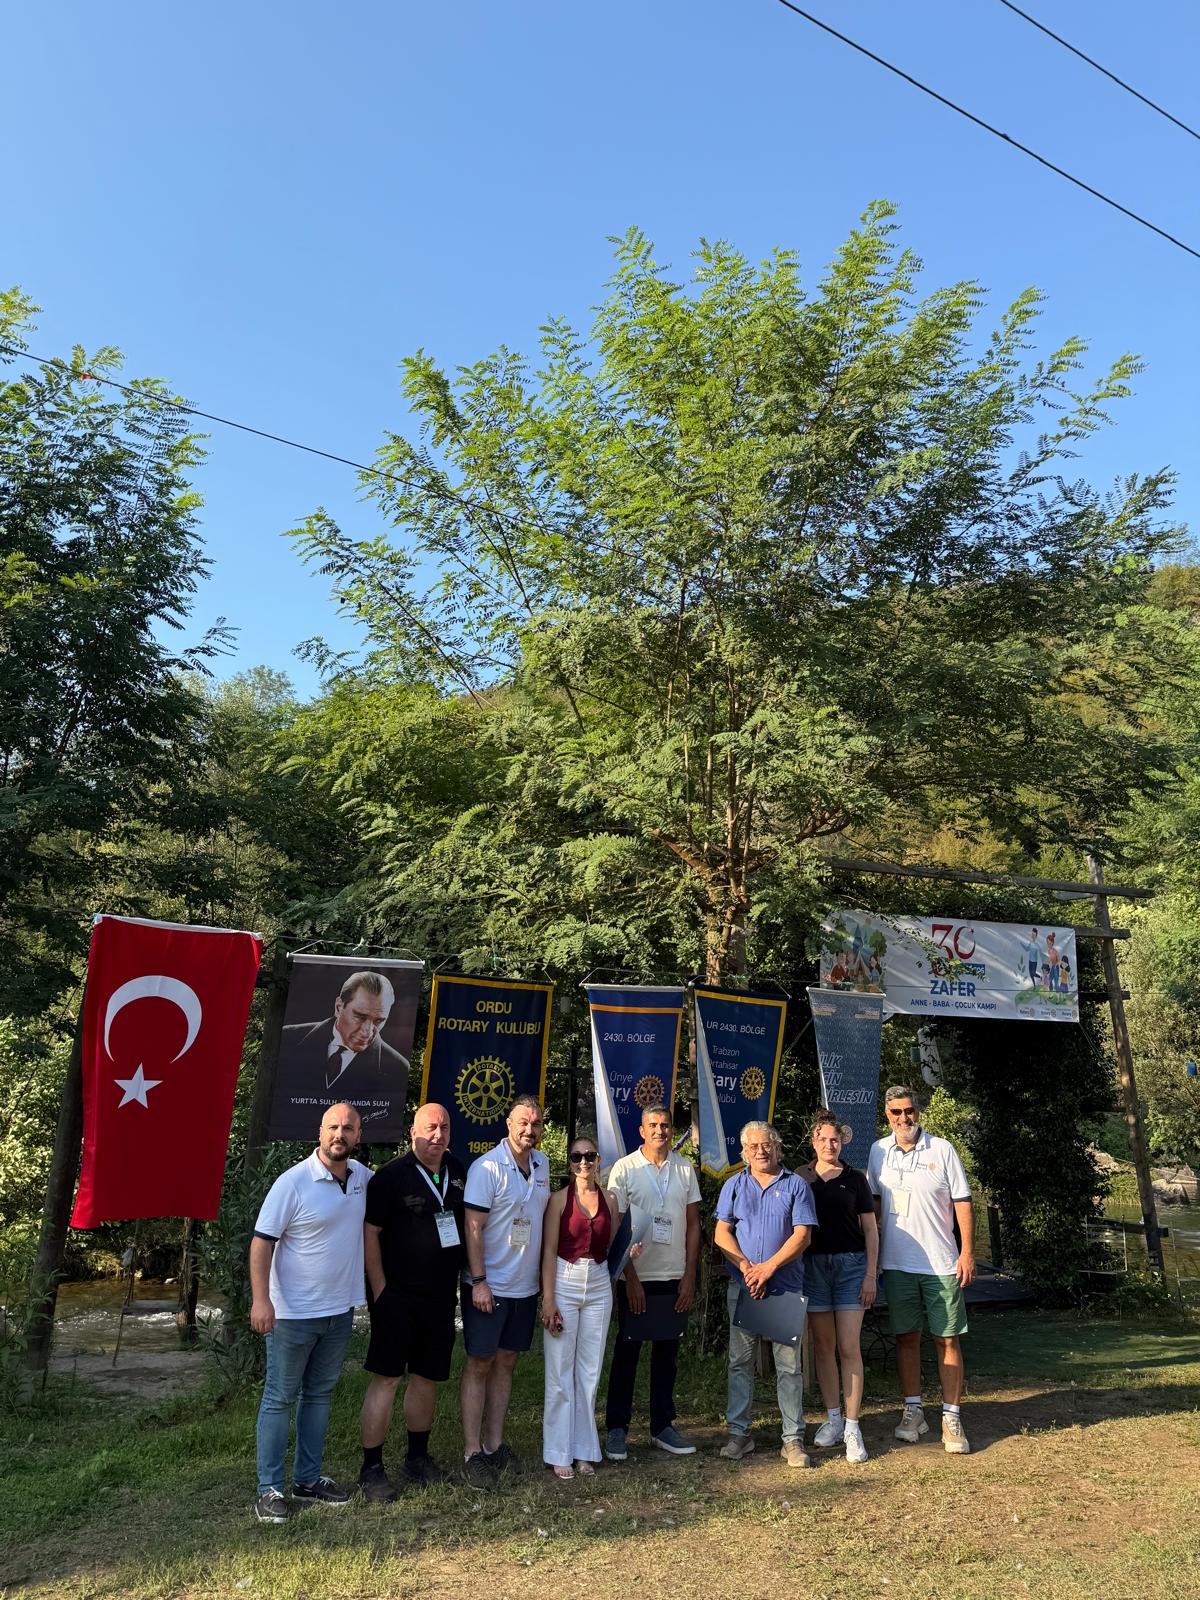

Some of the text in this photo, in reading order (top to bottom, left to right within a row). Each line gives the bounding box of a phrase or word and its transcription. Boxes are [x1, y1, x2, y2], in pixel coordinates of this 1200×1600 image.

[931, 923, 976, 977] 30
[930, 979, 976, 997] ZAFER
[476, 1001, 513, 1014] ORDU
[910, 998, 928, 1007] ANNE
[932, 1000, 950, 1008] BABA
[954, 1001, 976, 1010] ÇOCUK
[976, 1002, 997, 1011] KAMPI
[438, 1017, 490, 1033] ROTARY
[720, 1024, 739, 1033] 2430.
[740, 1025, 767, 1035] BÖLGE
[603, 1032, 656, 1043] 2430. BÖLGE
[712, 1045, 740, 1057] Trabzon
[477, 1062, 502, 1073] ROTARY
[710, 1060, 739, 1070] rtahisar
[290, 1097, 318, 1105] YURTTA
[372, 1100, 390, 1108] SULH
